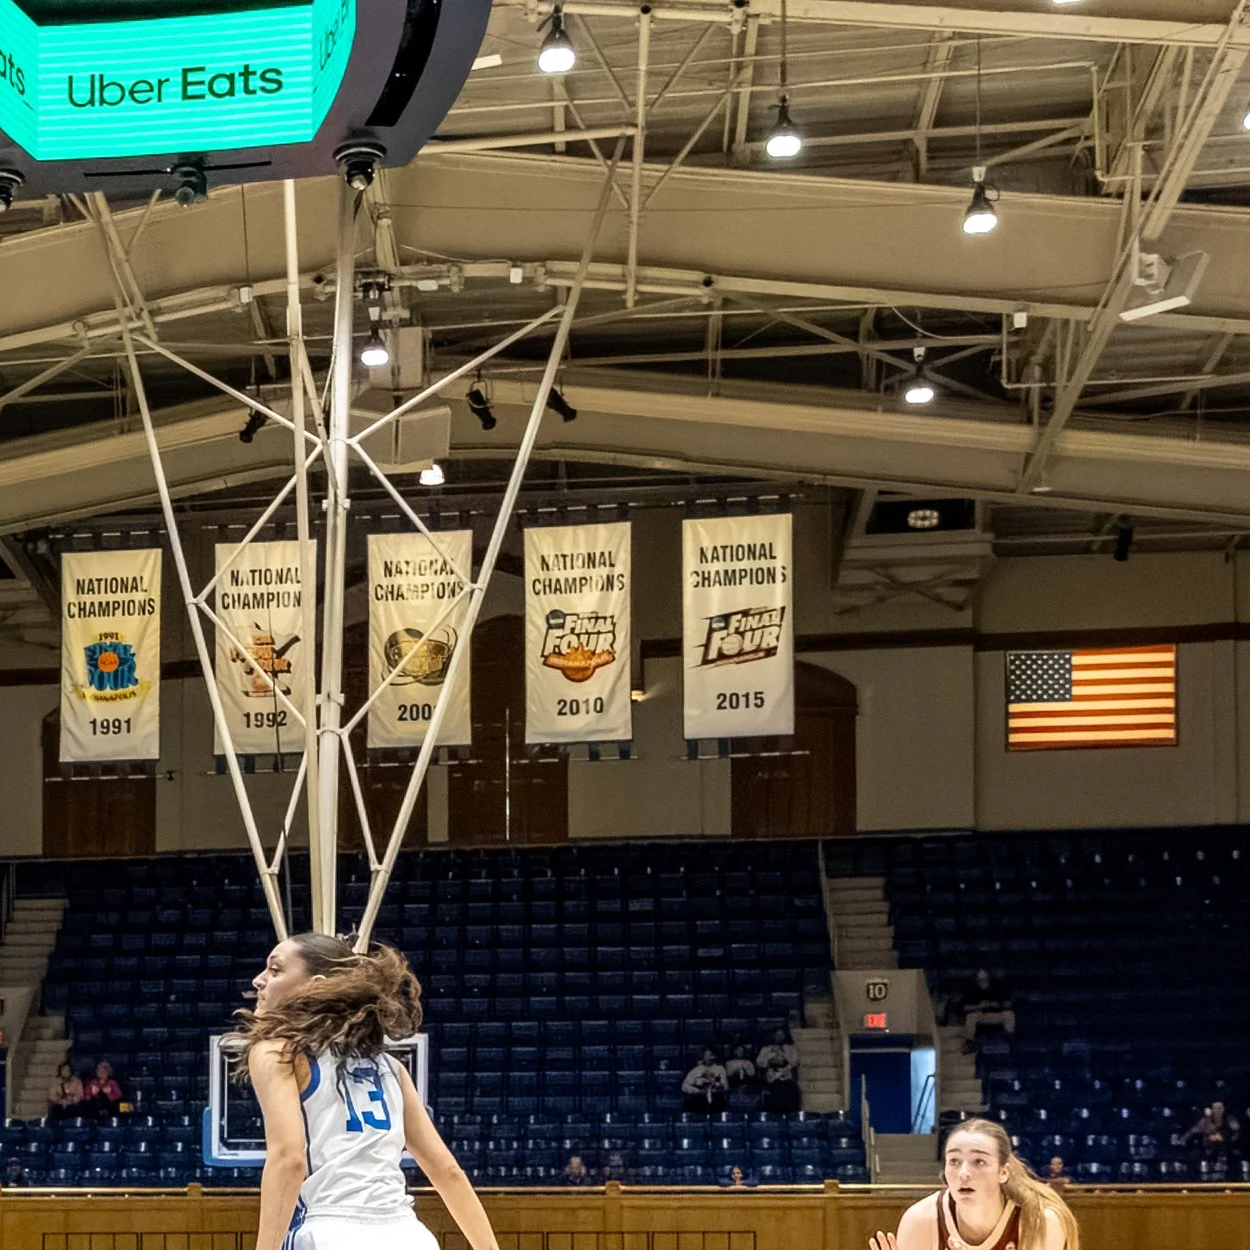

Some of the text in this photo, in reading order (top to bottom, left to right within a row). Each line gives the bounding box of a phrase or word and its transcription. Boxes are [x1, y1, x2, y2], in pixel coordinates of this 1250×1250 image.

[67, 65, 284, 109] Uber Eats
[540, 551, 616, 572] NATIONAL
[699, 542, 777, 564] NATIONAL
[230, 567, 301, 587] NATIONAL
[383, 557, 456, 578] NATIONAL
[690, 566, 787, 589] CHAMPIONS
[76, 575, 148, 596] NATIONAL
[375, 582, 466, 602] CHAMPIONS
[532, 573, 625, 596] CHAMPIONS
[67, 598, 156, 619] CHAMPIONS
[221, 590, 302, 611] CHAMPION
[563, 613, 614, 634] FINAL
[728, 609, 781, 635] FINAL
[542, 628, 616, 657] FOUR
[708, 626, 781, 661] FOUR
[556, 697, 604, 716] 2010
[715, 691, 765, 711] 2015
[243, 710, 288, 729] 1992
[397, 703, 437, 722] 200
[89, 717, 132, 736] 1991
[869, 984, 886, 999] 10
[340, 1063, 392, 1133] 13
